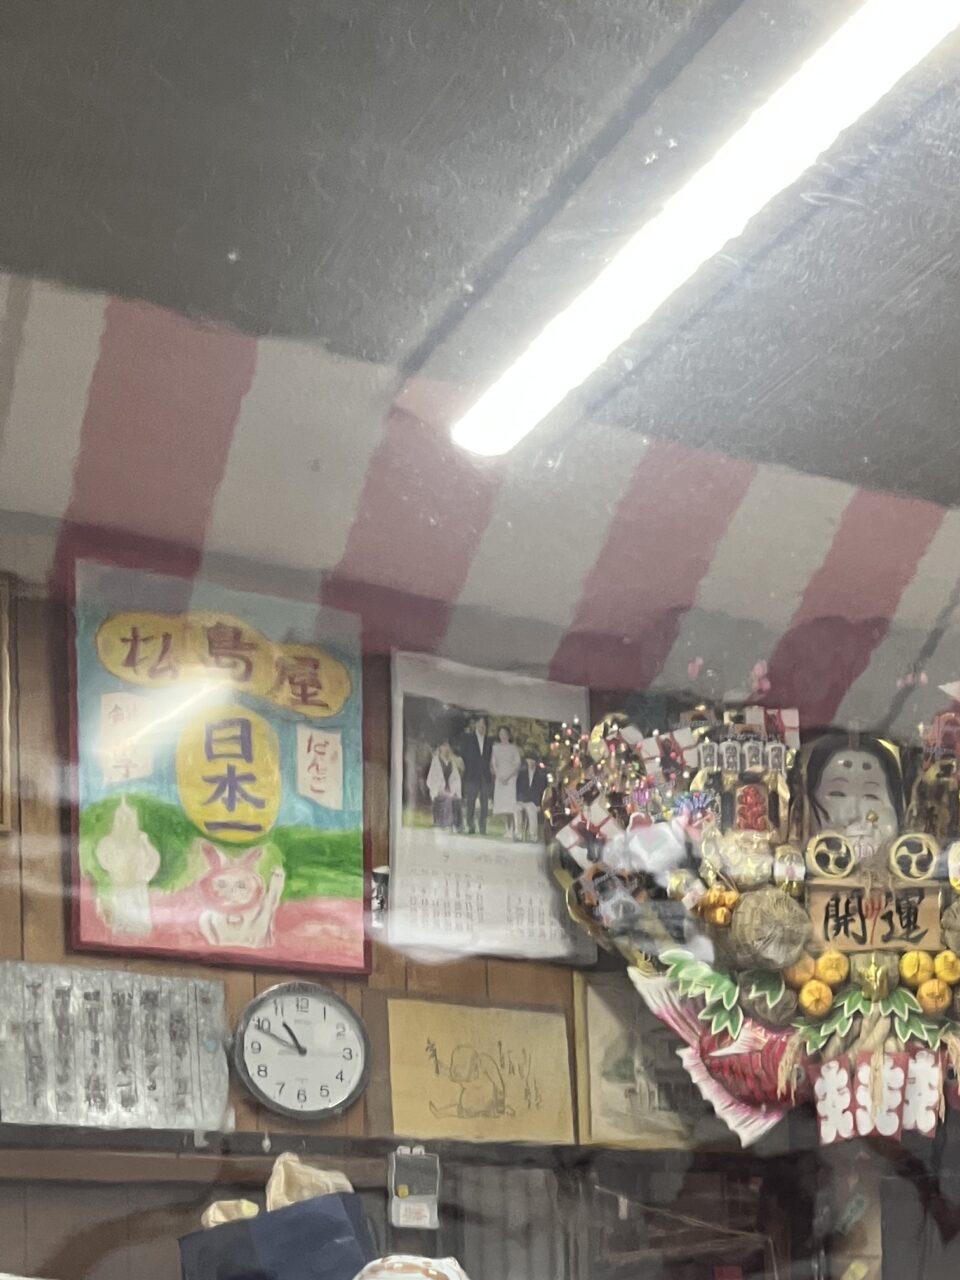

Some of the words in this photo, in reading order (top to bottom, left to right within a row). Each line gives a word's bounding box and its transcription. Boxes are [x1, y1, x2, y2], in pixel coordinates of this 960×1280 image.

[120, 622, 330, 710] 松島屋
[202, 717, 266, 833] 日本一
[250, 1041, 261, 1054] 9
[342, 1048, 353, 1060] 3
[257, 1064, 268, 1078] 8
[335, 1070, 344, 1082] 4
[276, 1082, 286, 1095] 7
[320, 1085, 330, 1098] 5
[297, 1090, 307, 1103] 6
